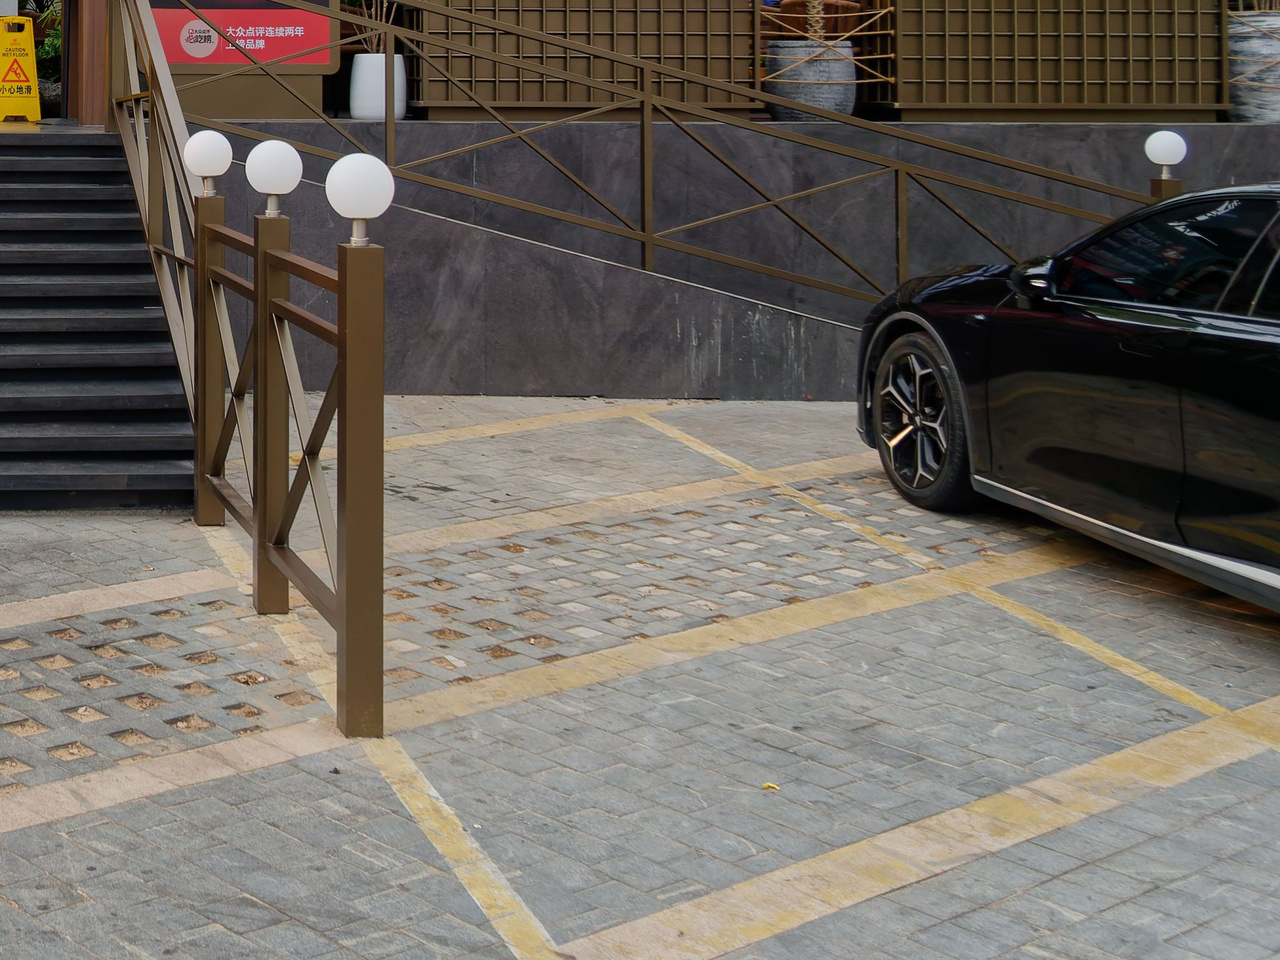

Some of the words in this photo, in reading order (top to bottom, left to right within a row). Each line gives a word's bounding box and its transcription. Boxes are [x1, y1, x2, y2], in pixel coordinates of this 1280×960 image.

[225, 26, 304, 37] 大众点评连续两年
[0, 84, 32, 95] 小心地滑
